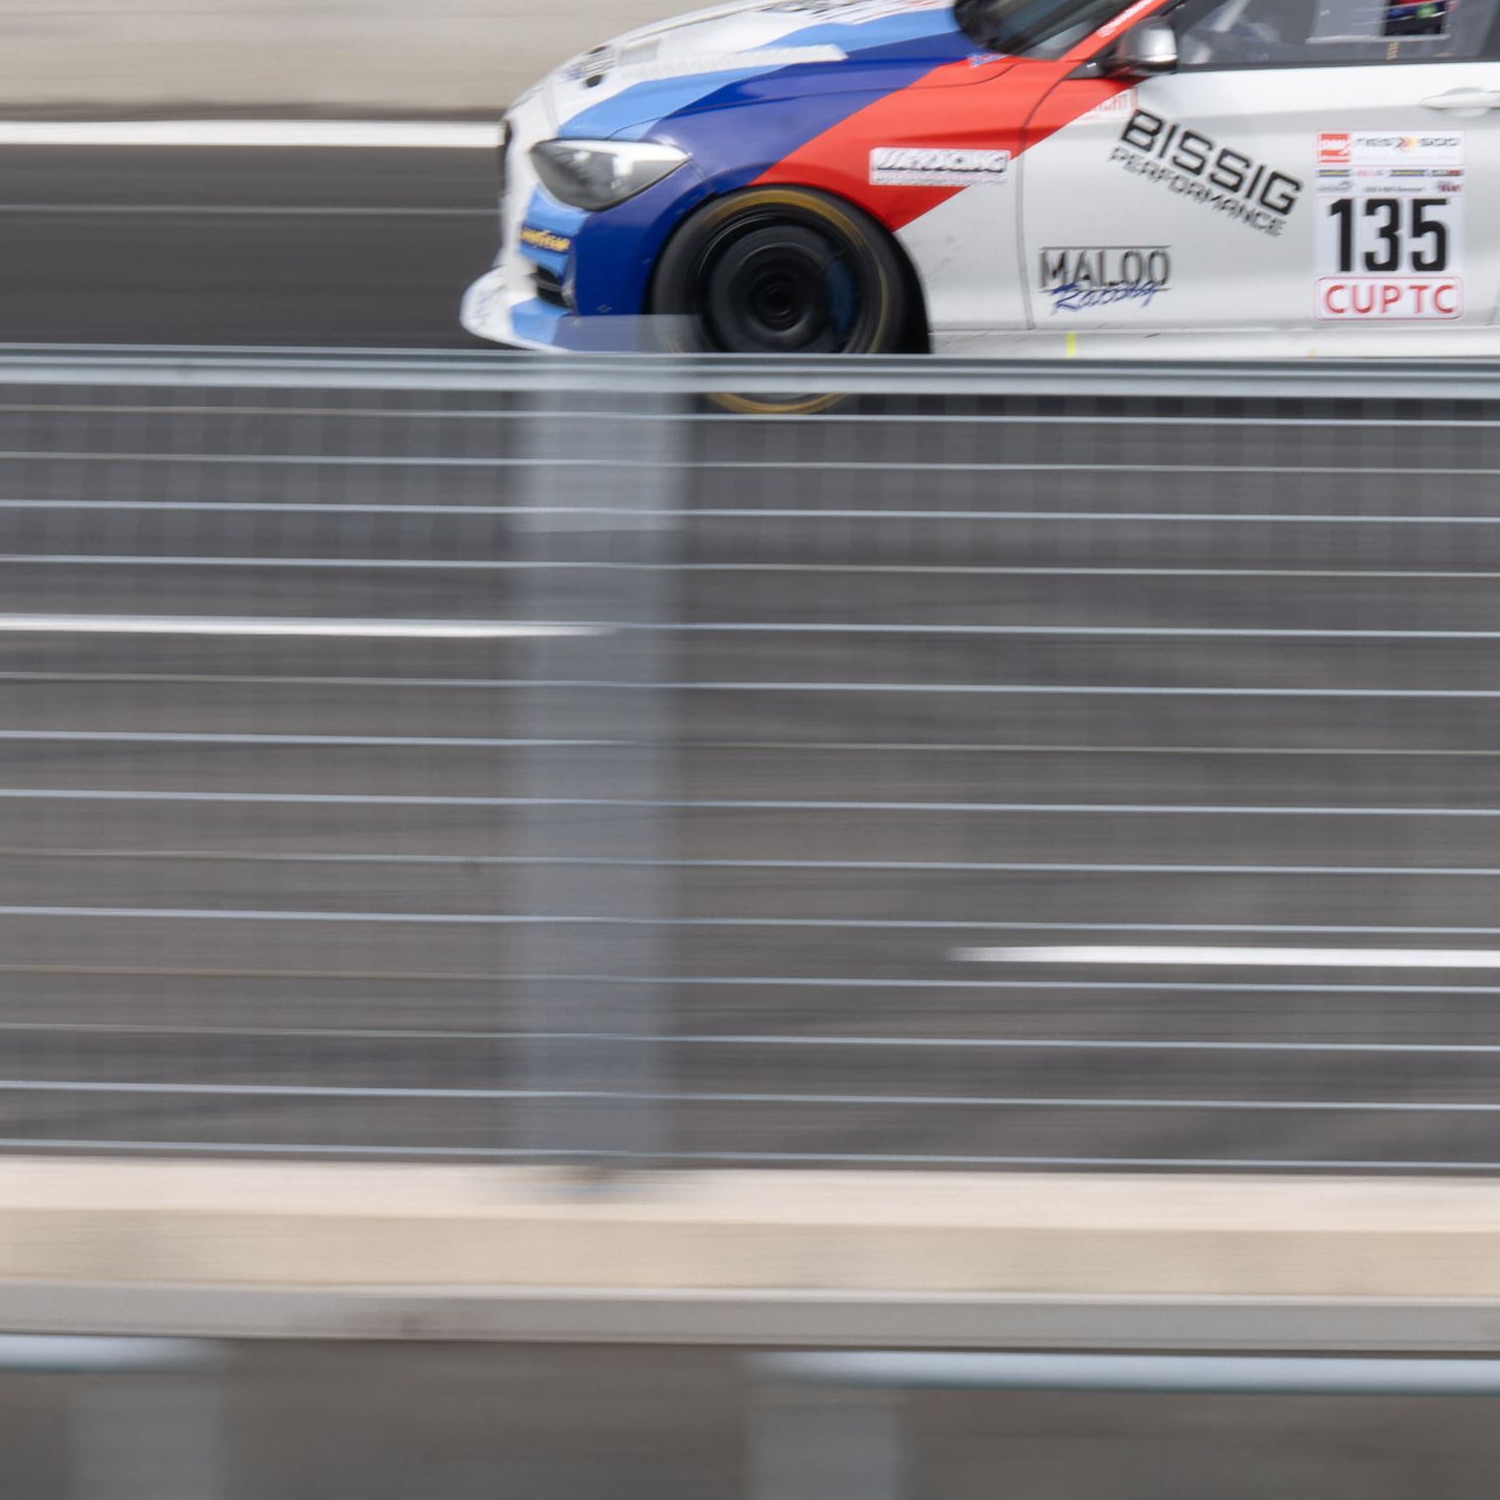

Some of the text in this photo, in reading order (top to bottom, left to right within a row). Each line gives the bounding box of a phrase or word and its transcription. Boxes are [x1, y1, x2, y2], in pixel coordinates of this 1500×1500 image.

[1108, 146, 1288, 238] PERFORMANCE
[1120, 108, 1304, 216] BISSIG
[1038, 249, 1172, 288] MALOO
[1328, 197, 1449, 272] 135
